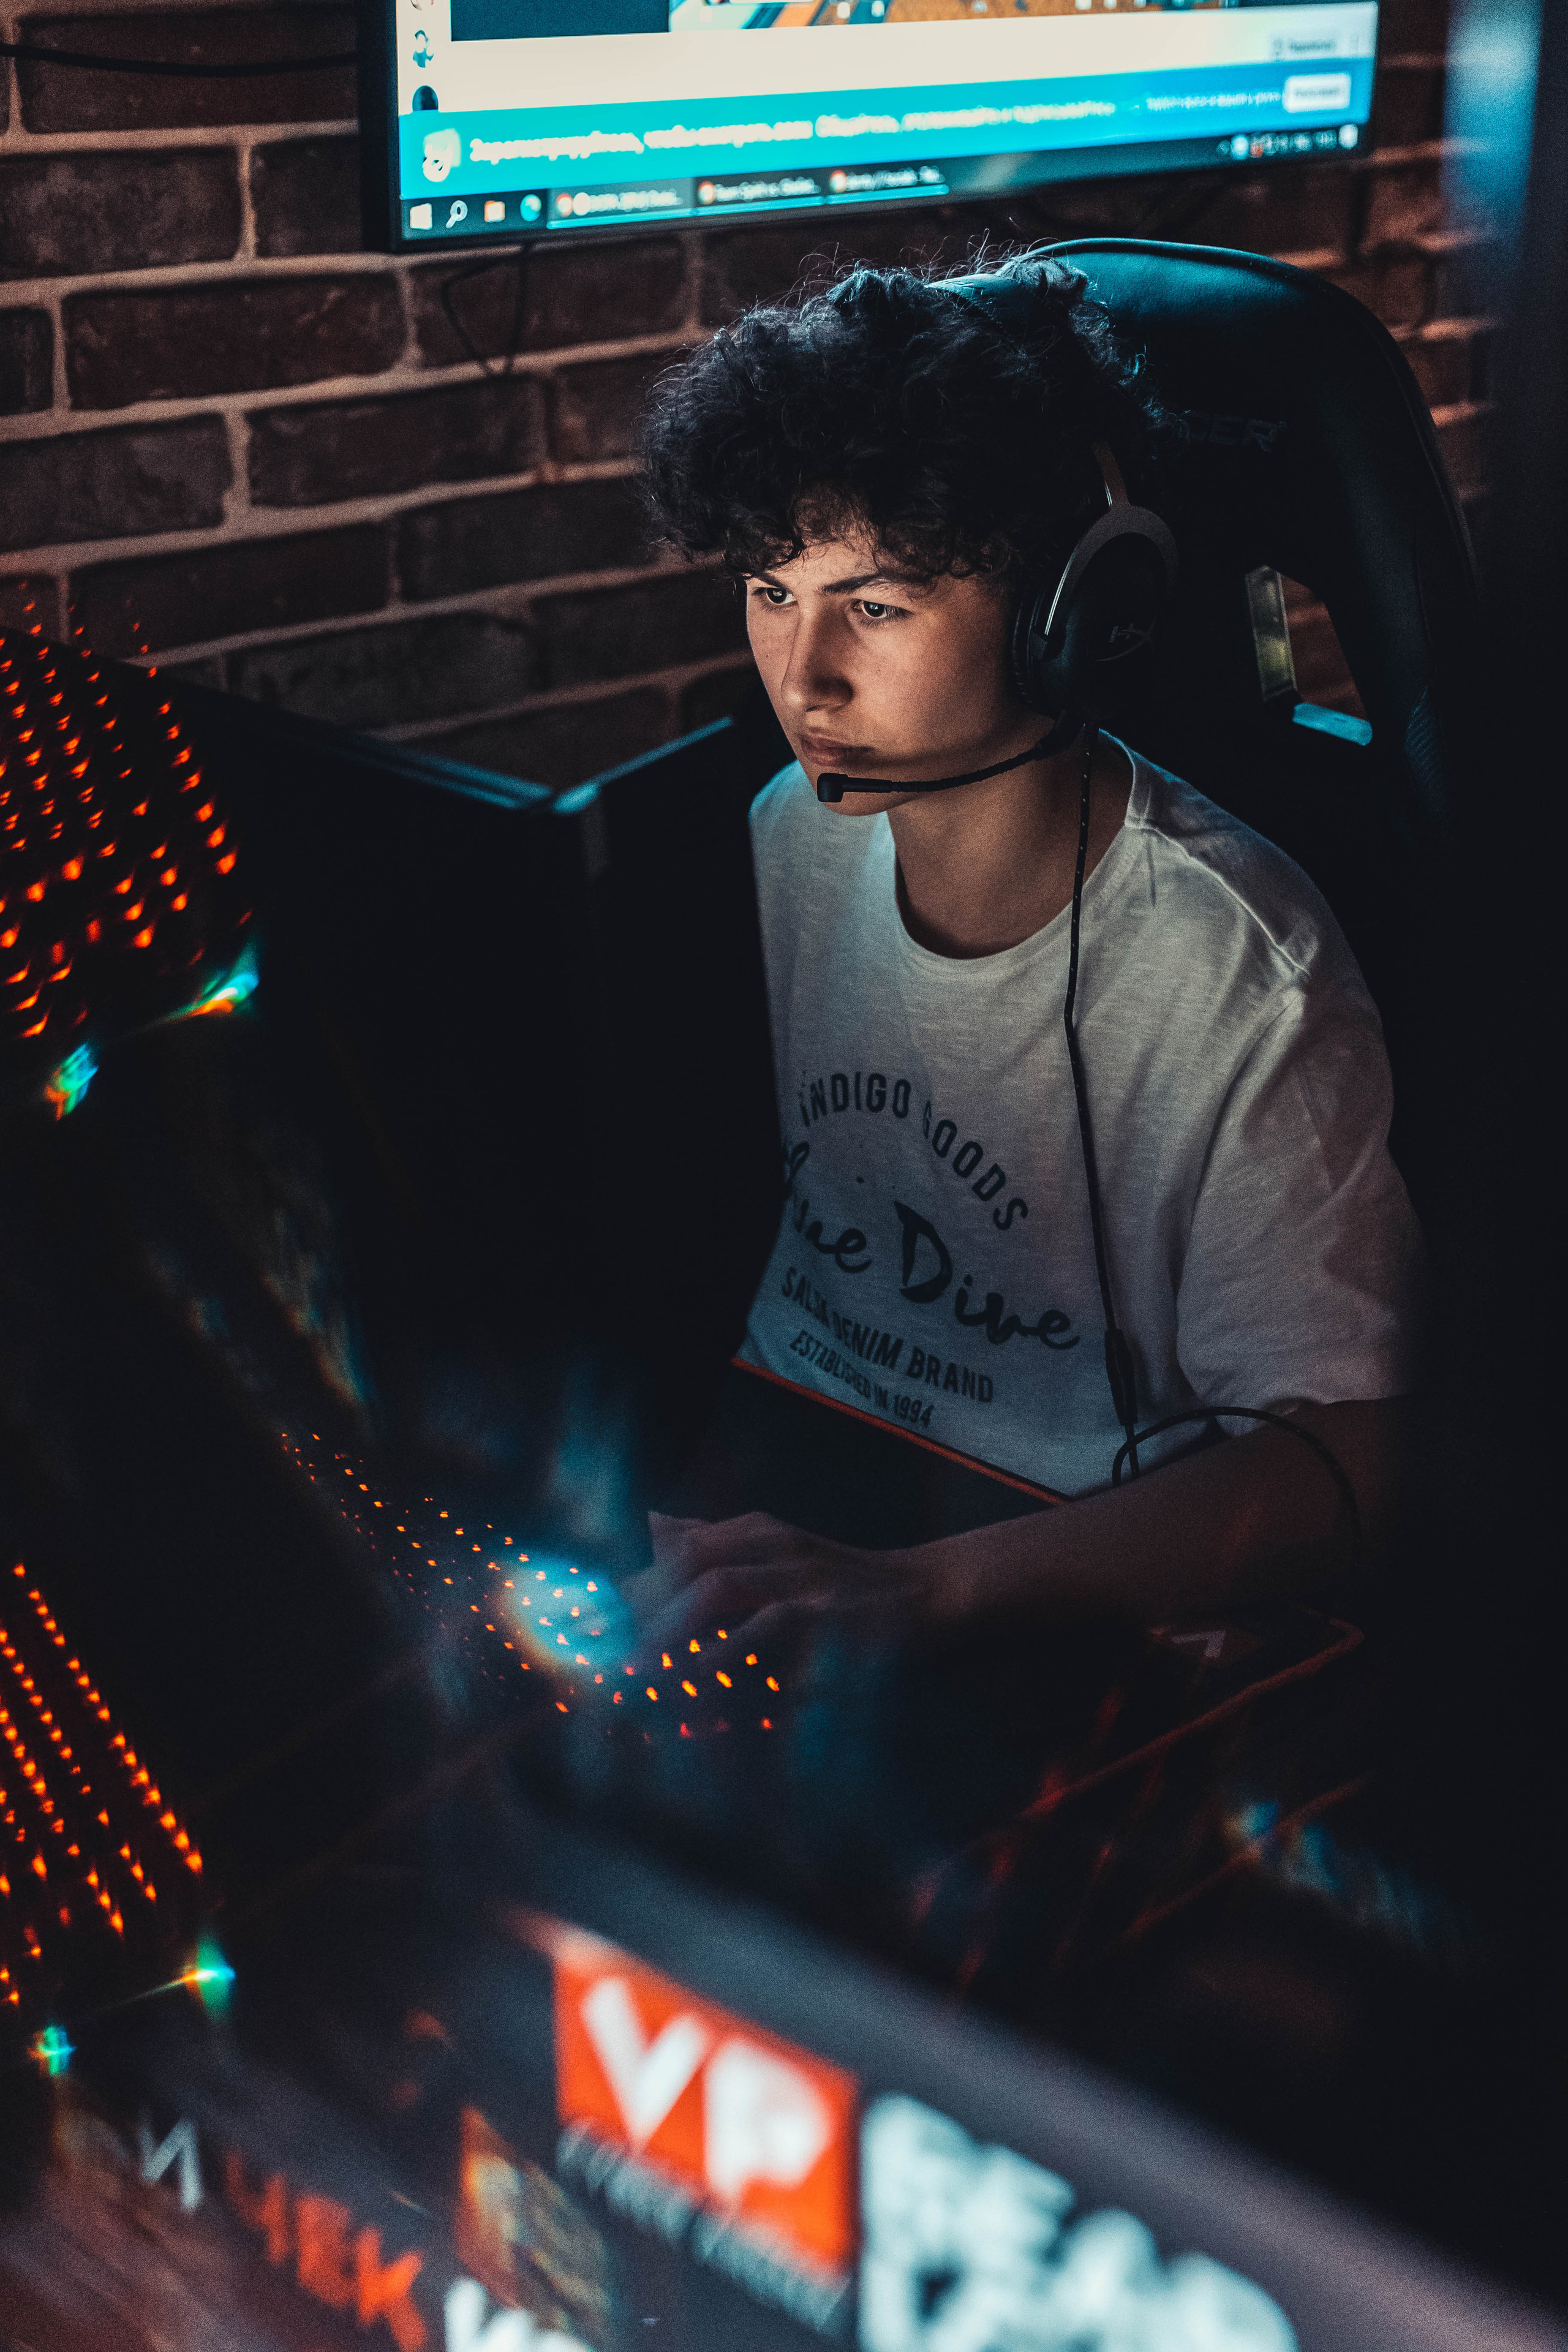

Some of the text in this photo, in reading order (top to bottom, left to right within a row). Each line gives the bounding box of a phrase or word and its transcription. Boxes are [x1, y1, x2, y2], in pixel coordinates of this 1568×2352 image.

[798, 1072, 911, 1126] INDIGO
[892, 1199, 1082, 1350] Dive
[907, 1346, 993, 1403] BRAND
[893, 1393, 935, 1428] 1994
